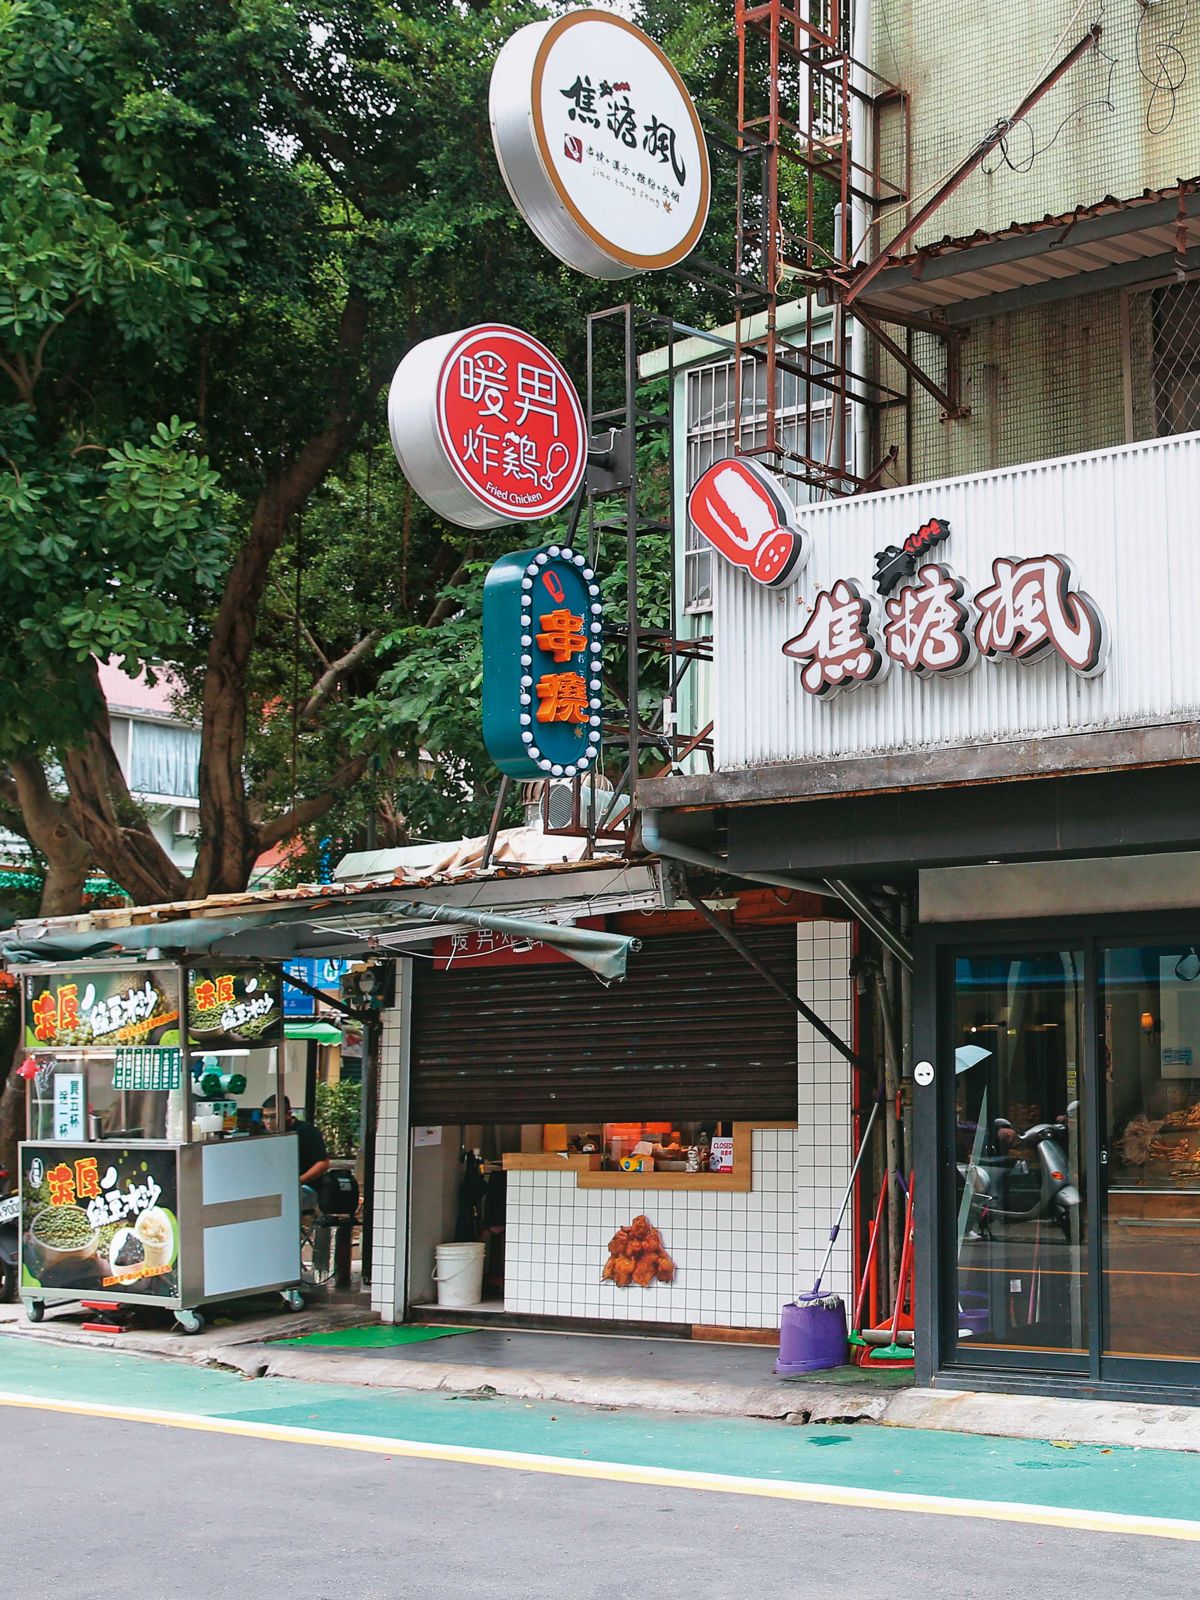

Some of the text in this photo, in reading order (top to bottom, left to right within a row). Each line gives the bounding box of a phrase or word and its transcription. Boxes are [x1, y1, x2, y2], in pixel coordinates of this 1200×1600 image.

[560, 75, 686, 187] 焦糖楓
[459, 350, 559, 437] 暖男
[485, 481, 543, 505] Fried Chicken
[536, 608, 590, 724] 串燒
[782, 553, 1106, 699] 焦糖楓
[32, 983, 81, 1040] 濃厚
[47, 1157, 102, 1206] 濃厚
